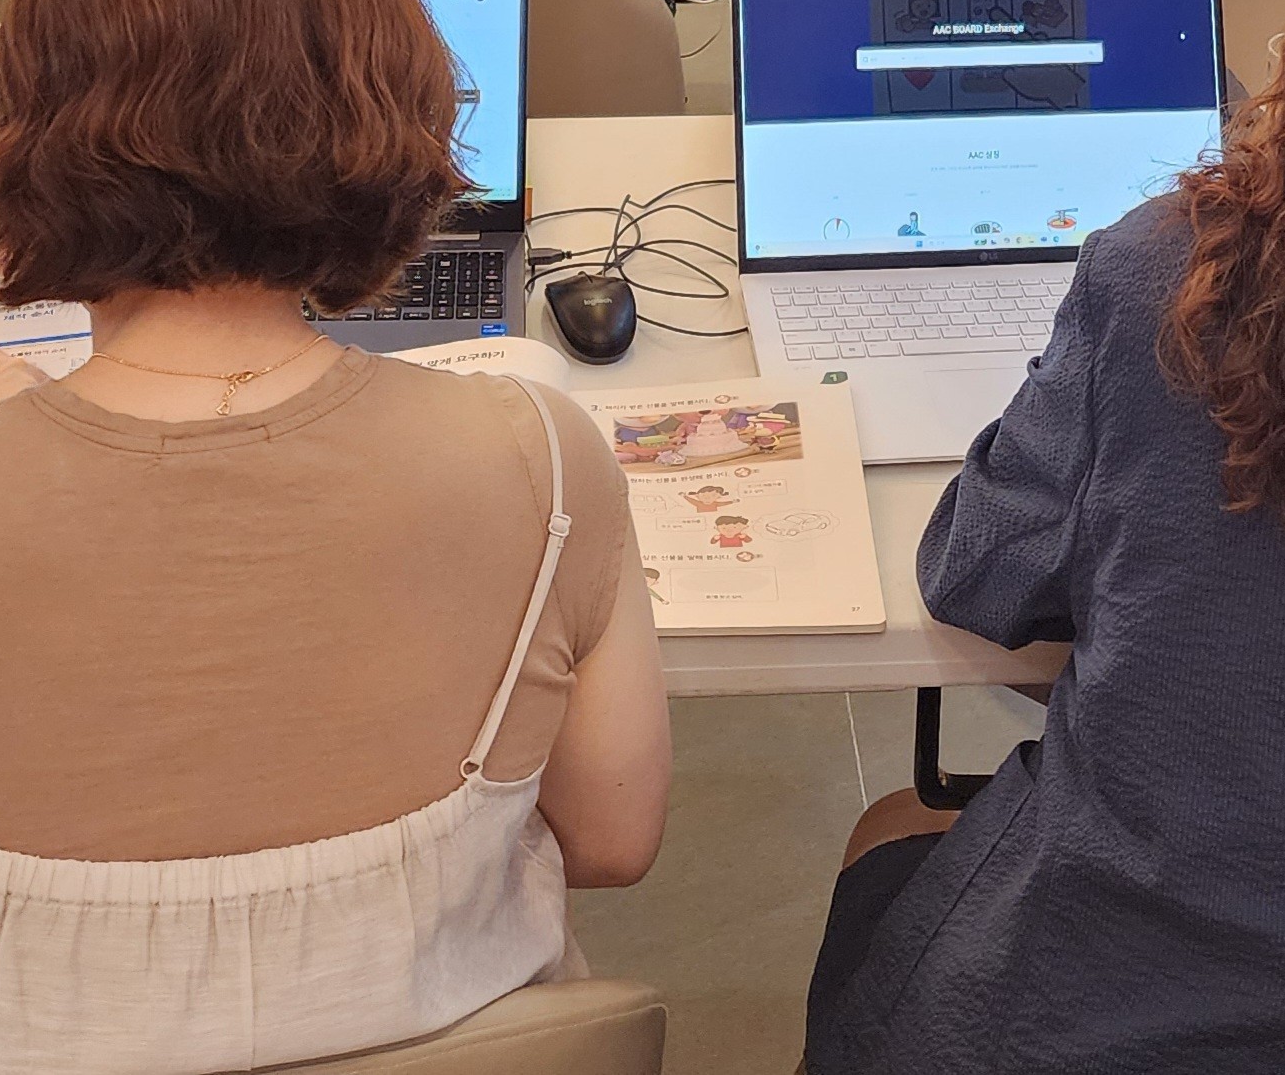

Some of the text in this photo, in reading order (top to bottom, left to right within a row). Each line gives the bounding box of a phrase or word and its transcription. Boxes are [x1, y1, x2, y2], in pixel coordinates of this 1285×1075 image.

[933, 22, 1025, 35] AAC BOARD Exchange
[968, 151, 984, 159] AAC
[583, 297, 613, 306] logitech
[456, 350, 505, 363] 요구하기
[590, 404, 602, 412] 3.
